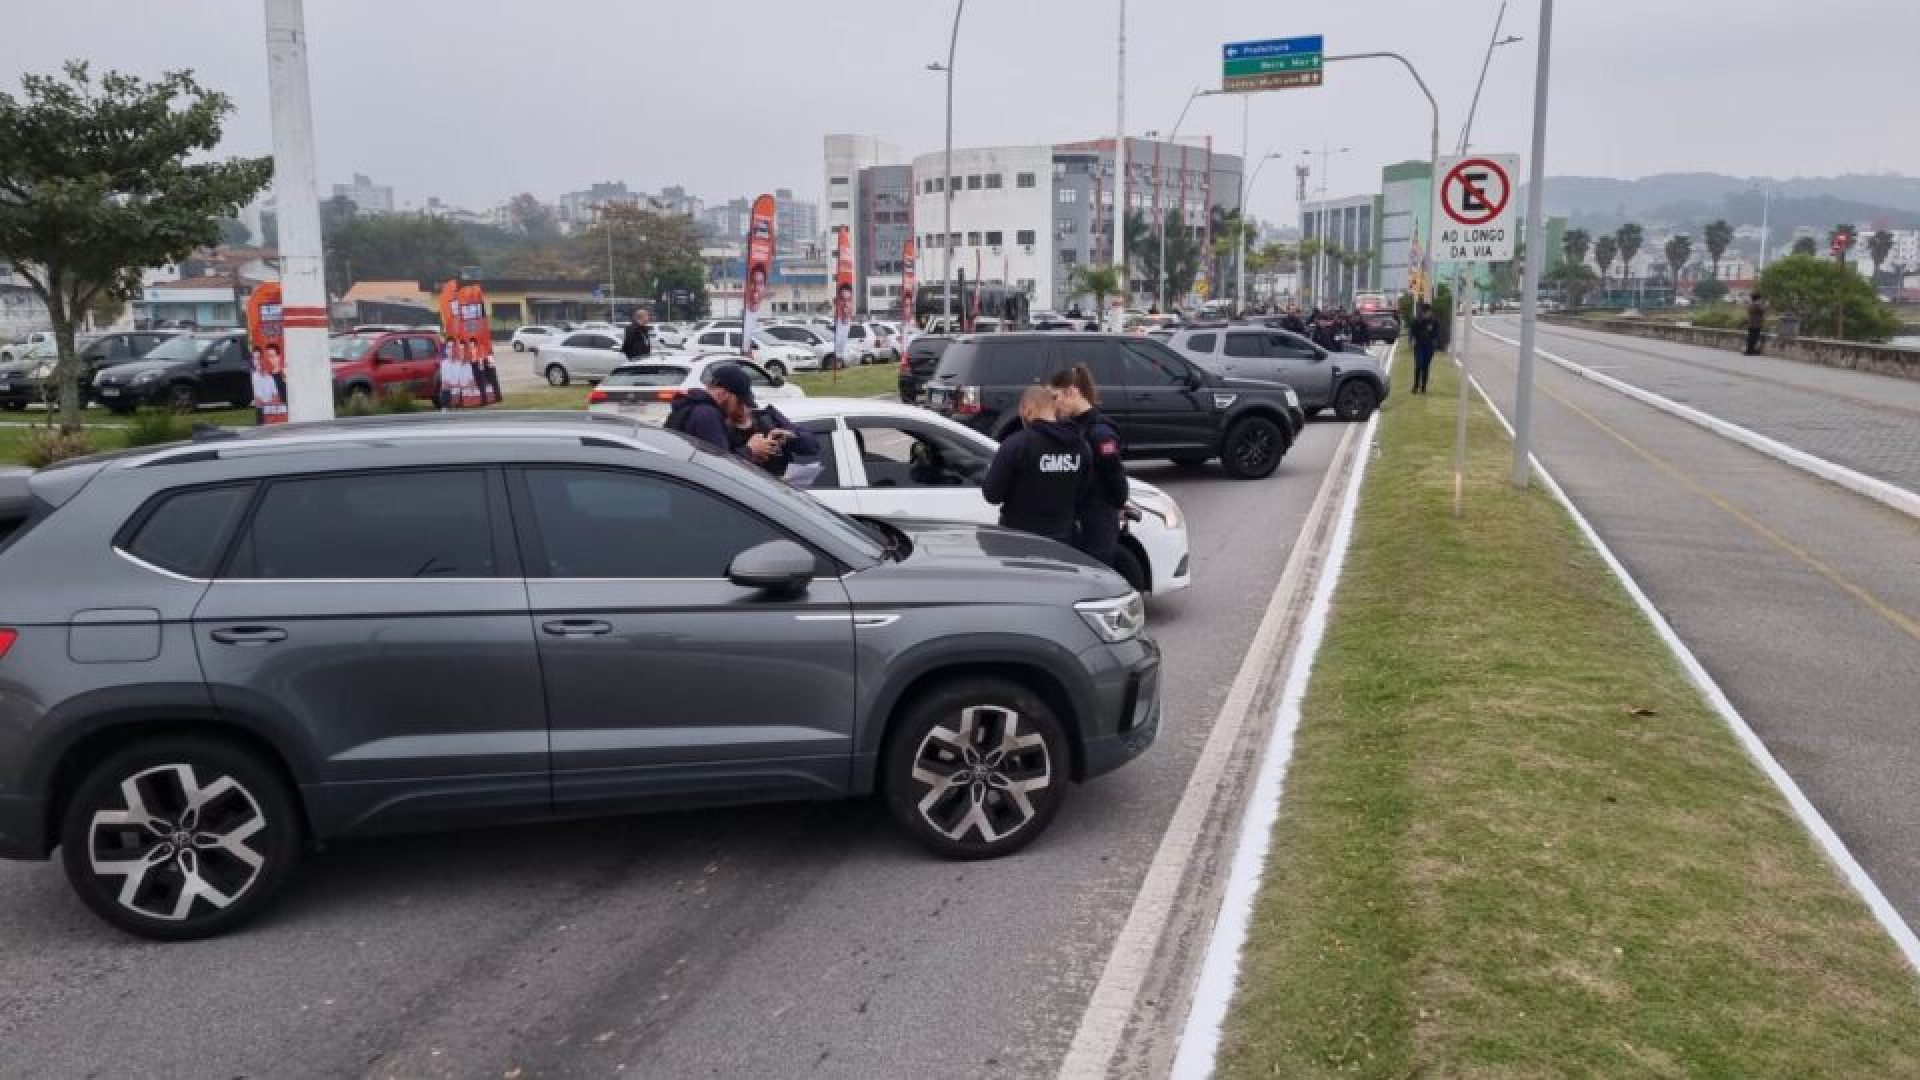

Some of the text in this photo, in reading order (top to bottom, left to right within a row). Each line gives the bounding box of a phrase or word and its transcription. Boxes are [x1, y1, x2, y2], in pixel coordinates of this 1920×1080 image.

[1291, 57, 1309, 66] Mar
[1441, 229, 1505, 243] AO LONGO
[1450, 245, 1493, 258] DA VIA
[1039, 453, 1081, 472] GMSJ
